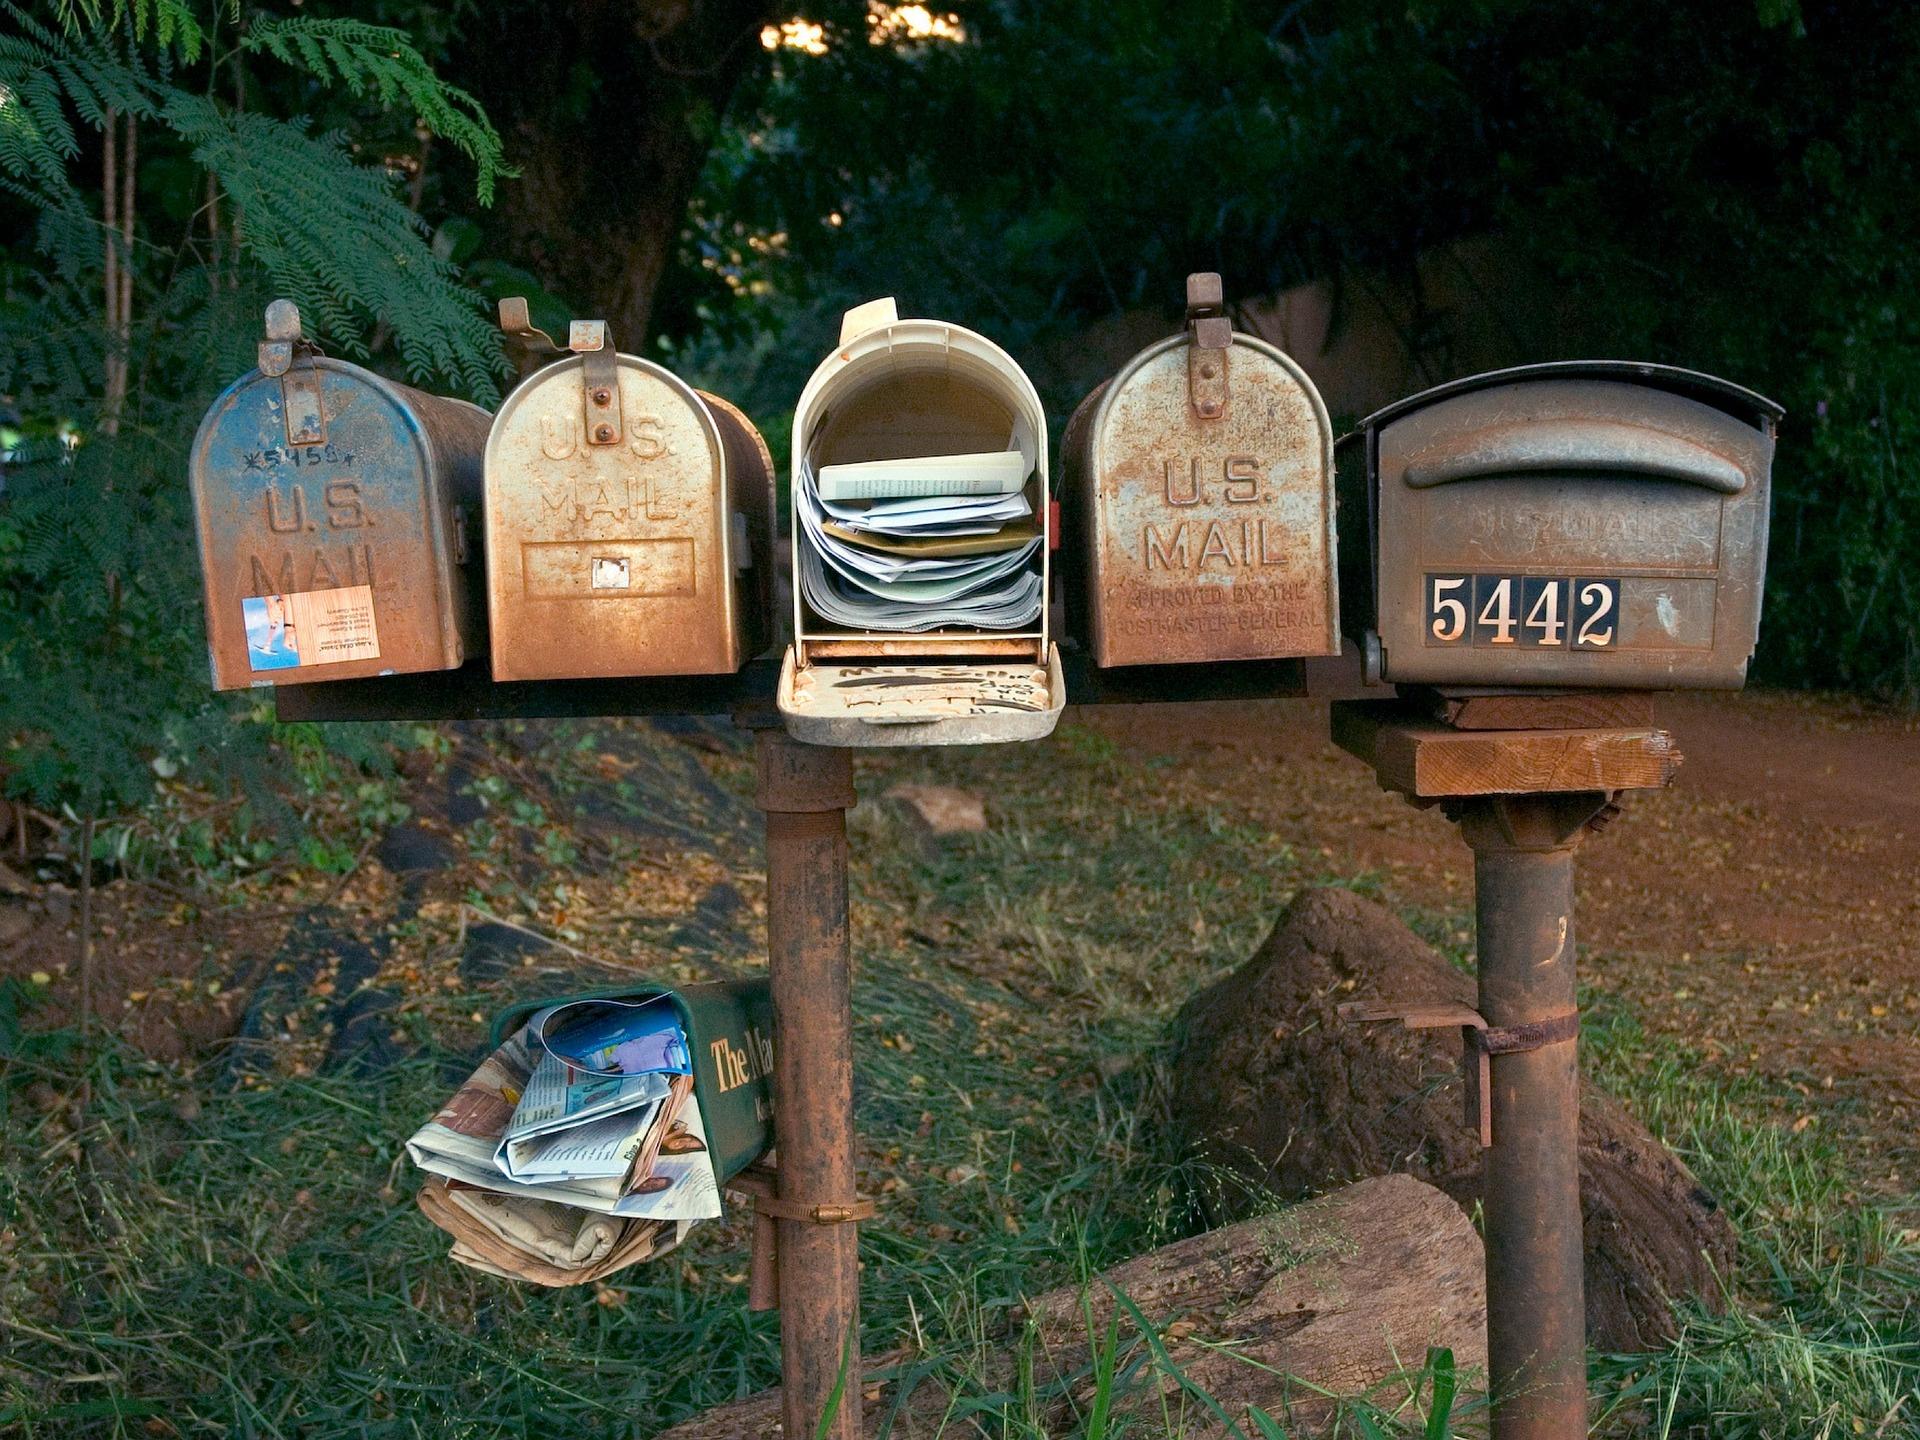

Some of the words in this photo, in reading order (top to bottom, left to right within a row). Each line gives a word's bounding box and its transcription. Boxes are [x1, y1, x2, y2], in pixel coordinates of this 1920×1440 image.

[266, 478, 376, 533] U.S.
[534, 477, 679, 523] MAIL
[1164, 456, 1273, 507] U.S.
[1144, 518, 1290, 570] MAIL
[1431, 577, 1613, 647] 5442
[710, 1037, 750, 1094] The
